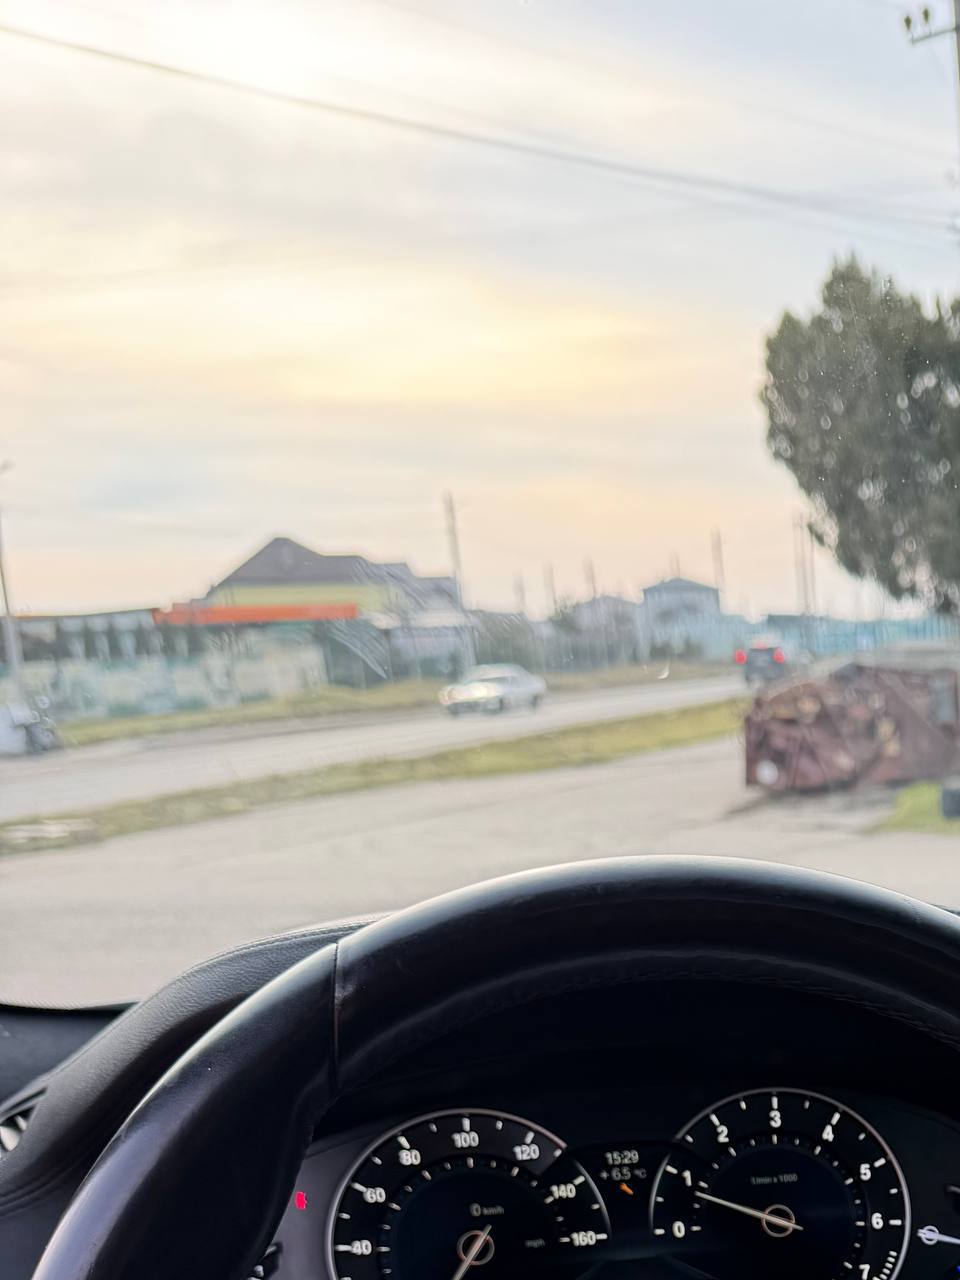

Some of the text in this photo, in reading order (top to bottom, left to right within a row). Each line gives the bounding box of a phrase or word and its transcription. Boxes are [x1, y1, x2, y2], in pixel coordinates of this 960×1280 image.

[769, 1110, 781, 1128] 3
[451, 1131, 479, 1148] 100
[716, 1125, 729, 1143] 2
[822, 1124, 834, 1142] 4
[398, 1149, 421, 1165] 80
[513, 1144, 540, 1160] 120
[605, 1150, 639, 1165] 15:29
[681, 1170, 692, 1187] 1
[860, 1163, 871, 1181] 5
[363, 1187, 386, 1203] 60
[550, 1183, 576, 1199] 140
[470, 1203, 481, 1217] 0
[871, 1212, 884, 1230] 6
[672, 1221, 685, 1238] 0
[570, 1230, 596, 1246] 160
[351, 1240, 372, 1255] 40
[859, 1264, 870, 1280] 7
